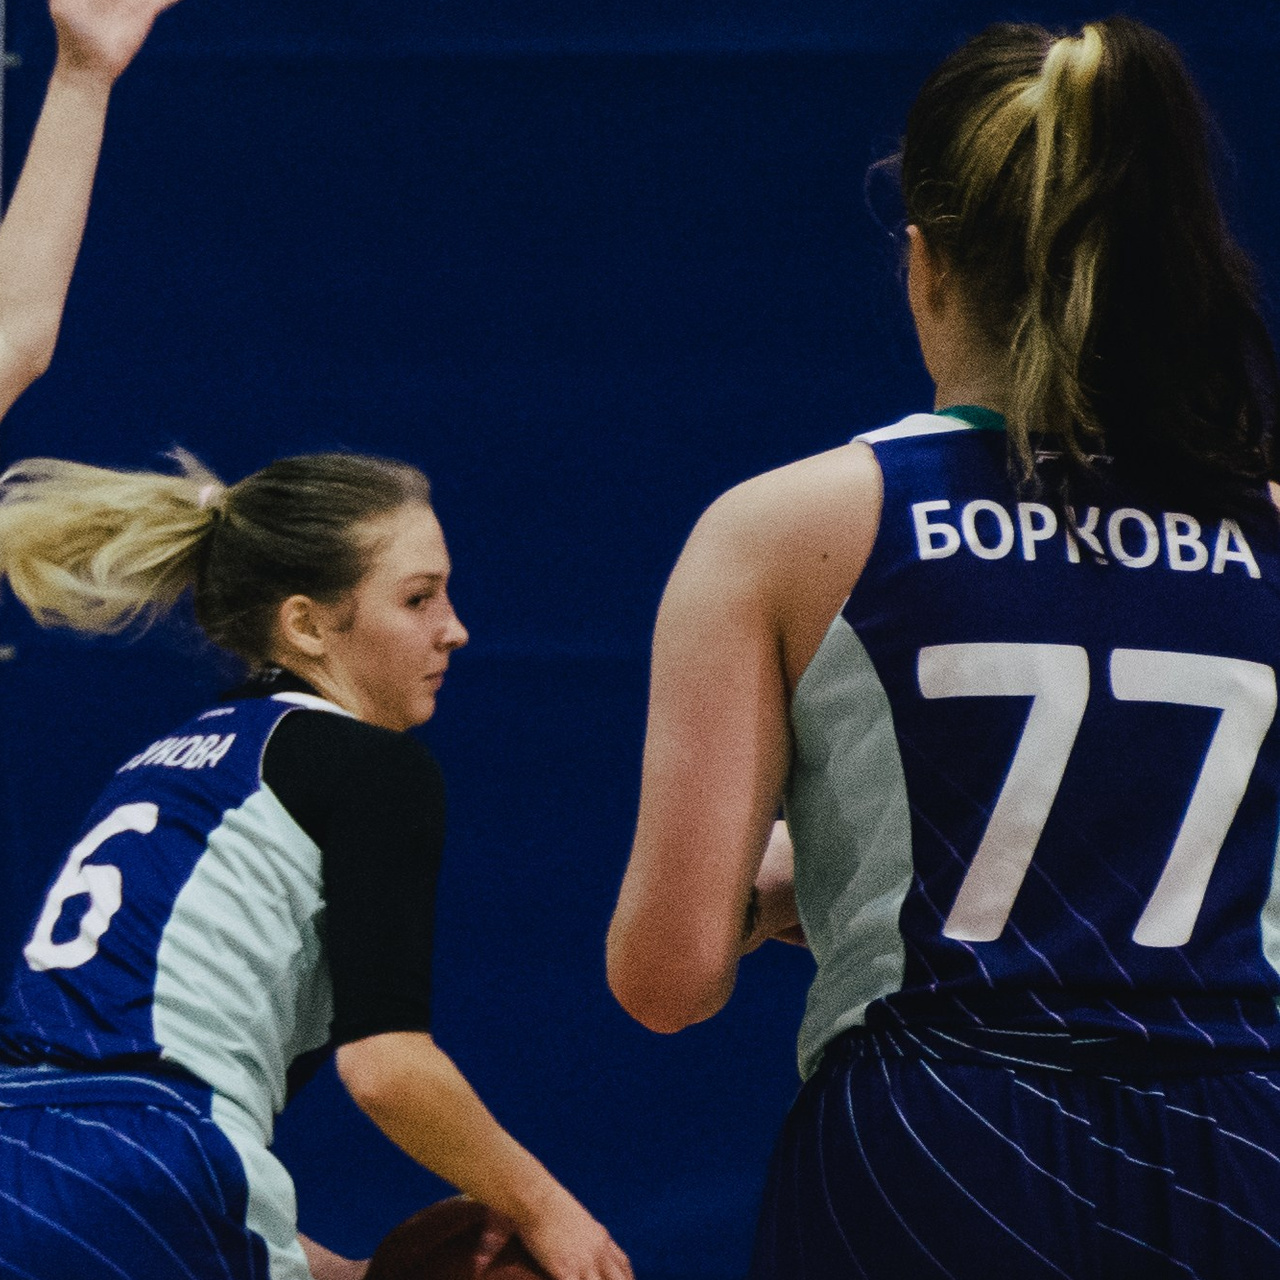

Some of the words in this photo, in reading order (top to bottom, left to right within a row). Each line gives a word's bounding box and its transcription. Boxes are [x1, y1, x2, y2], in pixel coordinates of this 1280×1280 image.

[911, 499, 1262, 580] БОРКОВА
[916, 641, 1278, 948] 77
[22, 802, 160, 972] 6
